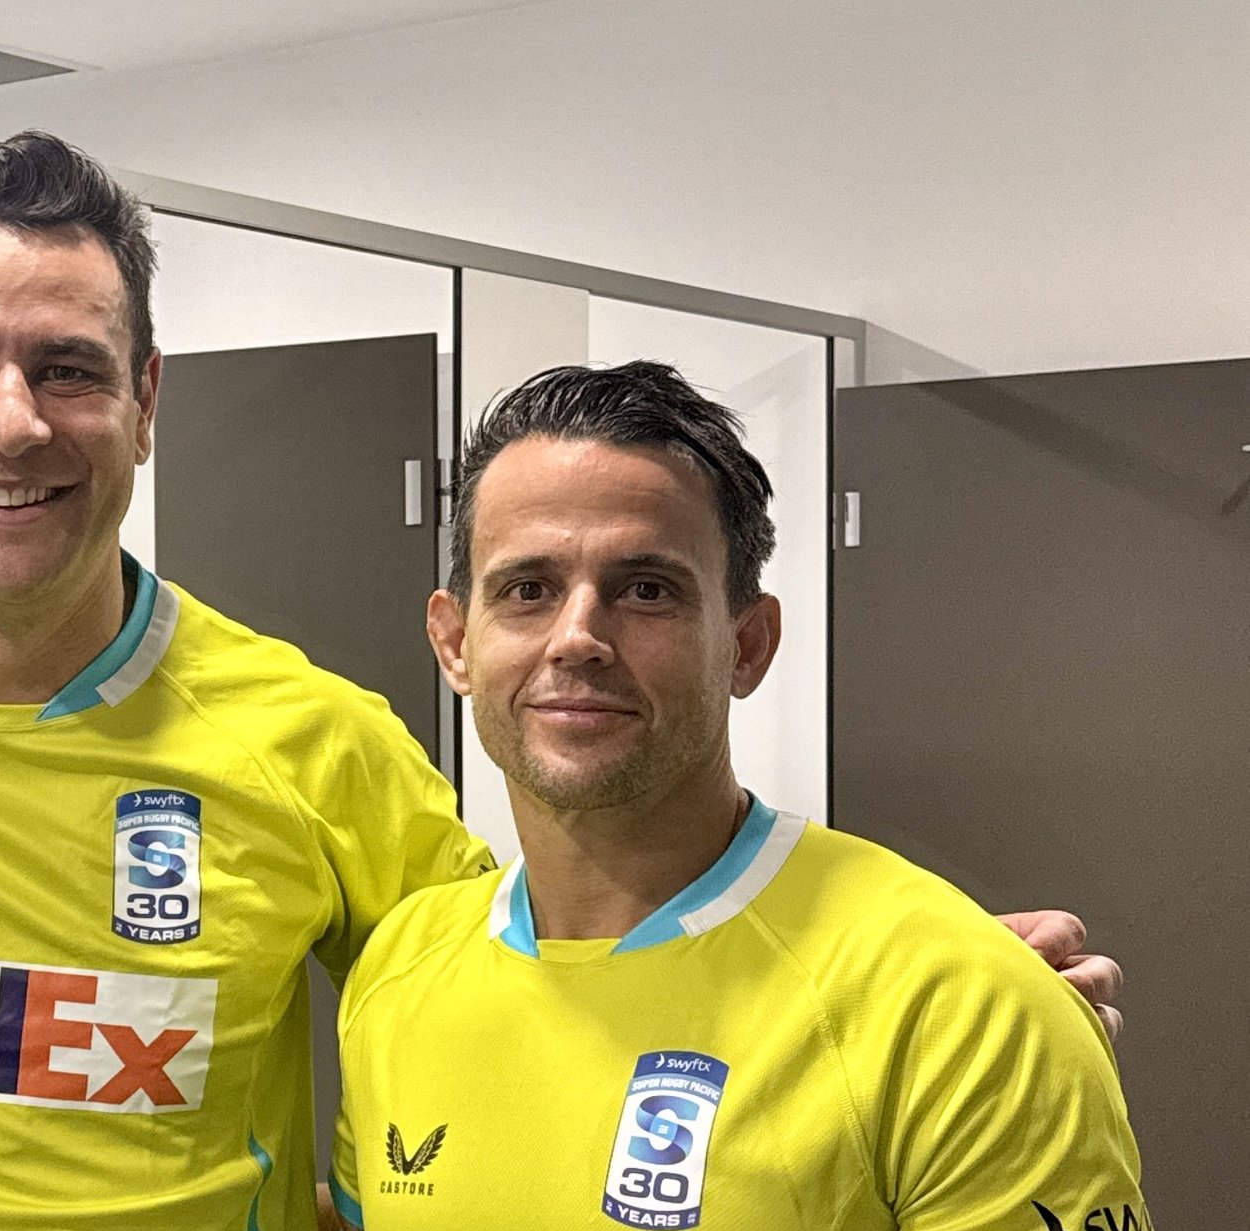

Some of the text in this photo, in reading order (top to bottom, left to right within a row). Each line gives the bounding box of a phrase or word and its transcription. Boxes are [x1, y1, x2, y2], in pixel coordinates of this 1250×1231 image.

[144, 793, 185, 808] swyftx
[126, 893, 189, 920] 30
[127, 924, 185, 941] YEARS
[666, 1057, 712, 1073] swyftx
[379, 1181, 435, 1197] CASTORE
[618, 1167, 690, 1205] 30
[617, 1203, 681, 1227] YEARS
